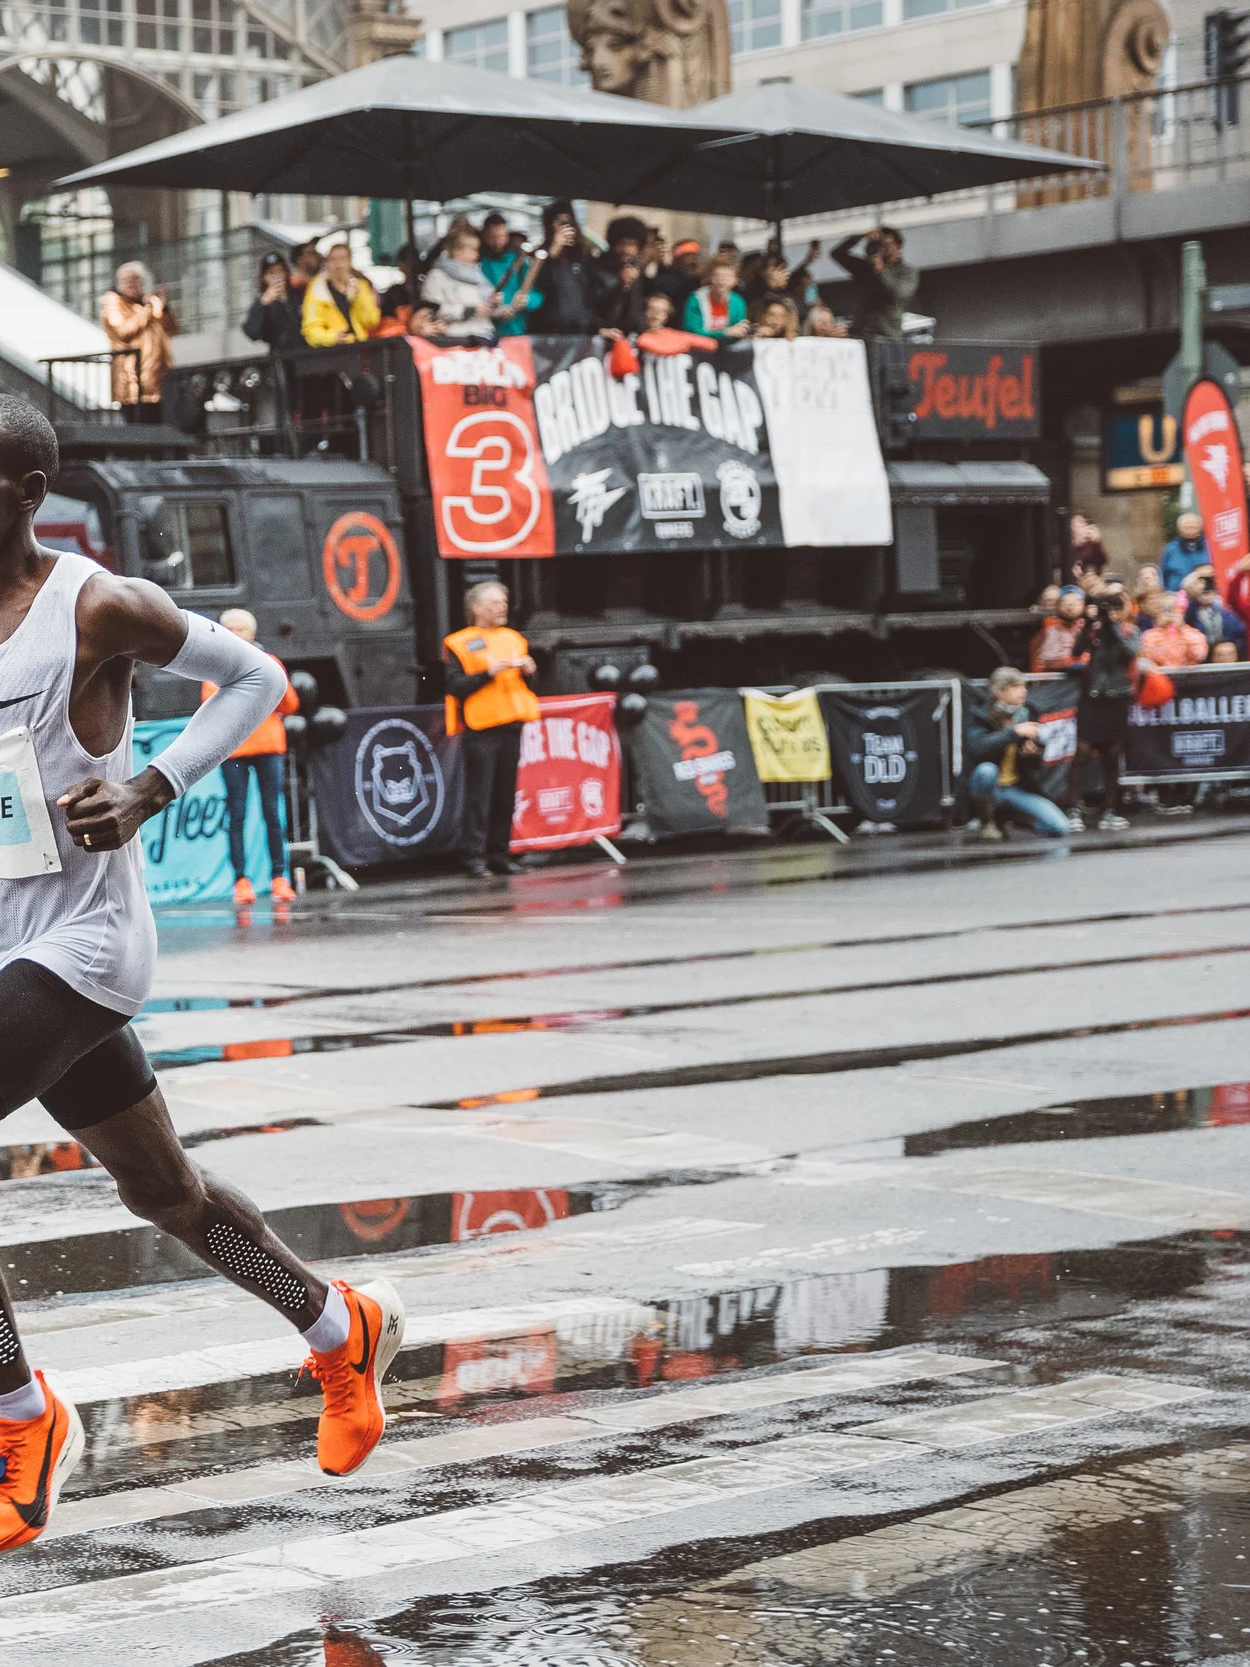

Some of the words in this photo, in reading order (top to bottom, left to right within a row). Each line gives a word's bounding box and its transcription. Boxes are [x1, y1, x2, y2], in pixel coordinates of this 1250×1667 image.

[644, 353, 700, 431] THE
[696, 362, 764, 455] GAP
[909, 352, 1036, 430] Teufel
[1138, 413, 1177, 464] U
[441, 410, 541, 552] 3
[544, 717, 577, 760] THE
[576, 721, 611, 768] GAP
